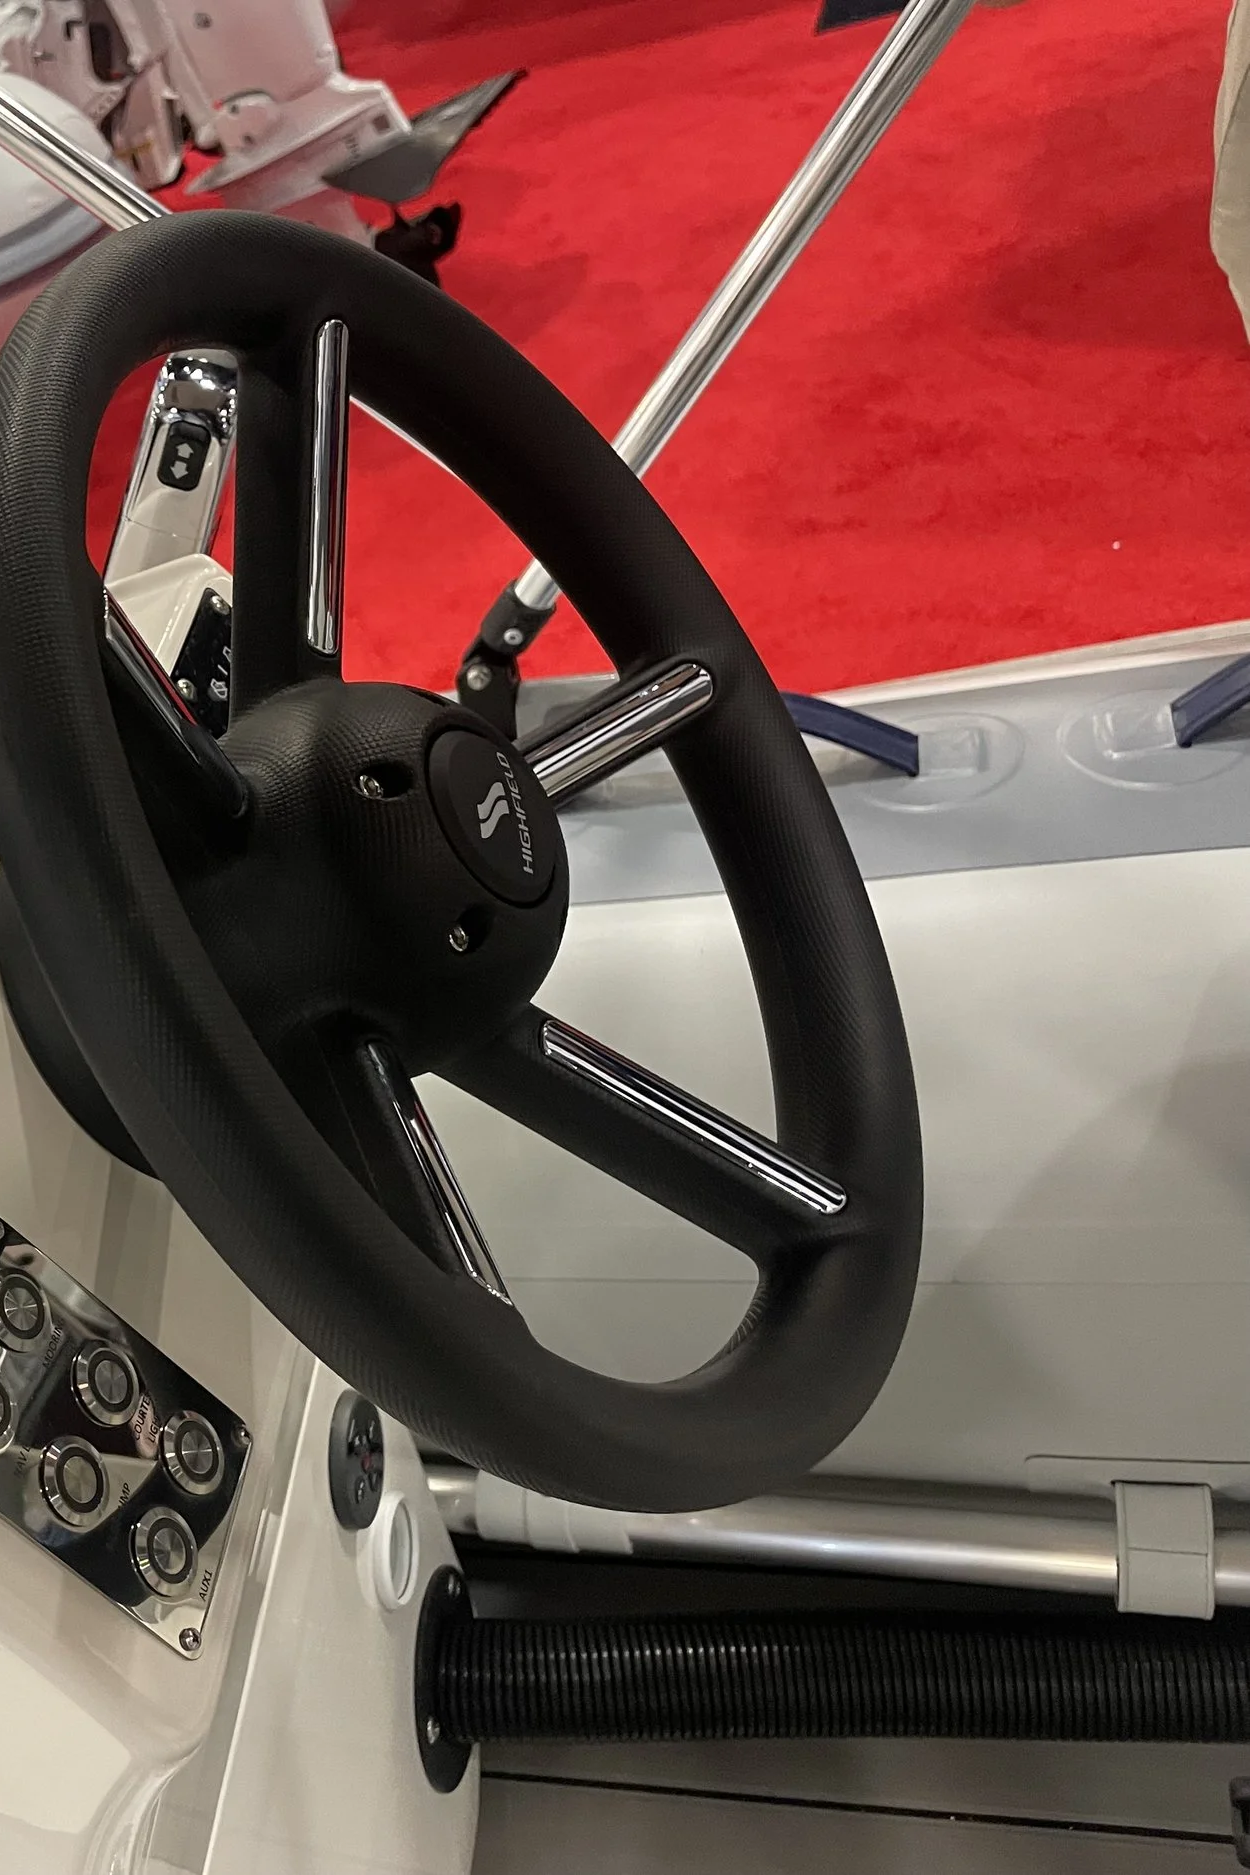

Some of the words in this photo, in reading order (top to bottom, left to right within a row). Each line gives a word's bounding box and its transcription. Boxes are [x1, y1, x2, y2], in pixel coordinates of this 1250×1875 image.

[496, 752, 534, 874] HIGHFIELD
[42, 1318, 65, 1367] MOORING
[199, 1570, 212, 1602] AUX1
